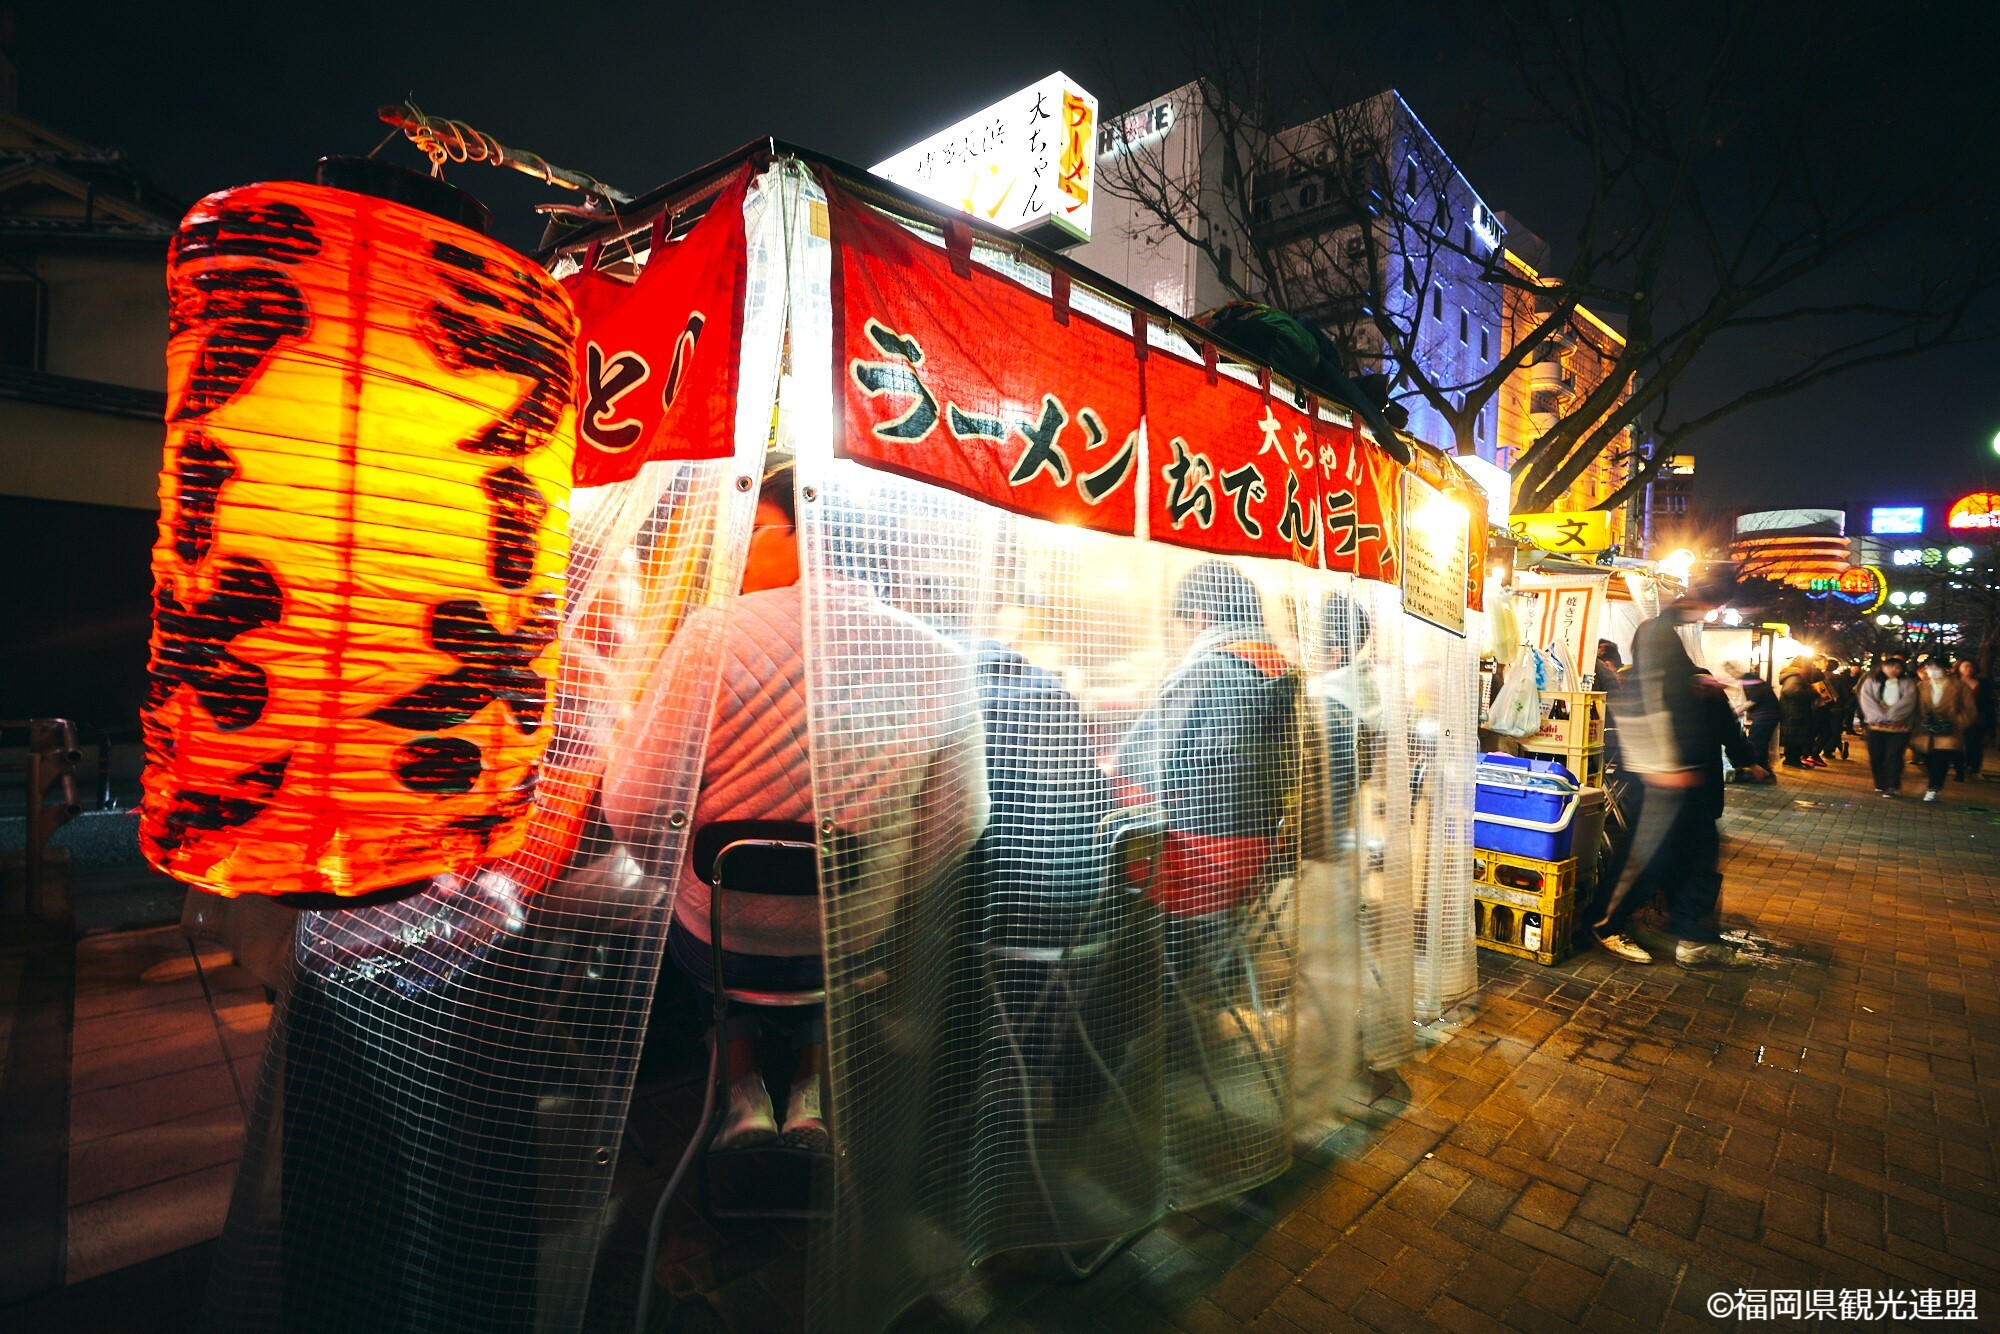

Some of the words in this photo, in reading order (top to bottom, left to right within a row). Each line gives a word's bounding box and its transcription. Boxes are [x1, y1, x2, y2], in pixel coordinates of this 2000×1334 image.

[1022, 91, 1051, 217] 大ちゃん
[1065, 94, 1088, 214] ラーメン
[849, 316, 1140, 506] ラーメン
[1164, 436, 1318, 551] おでん
[1554, 734, 1564, 742] 20
